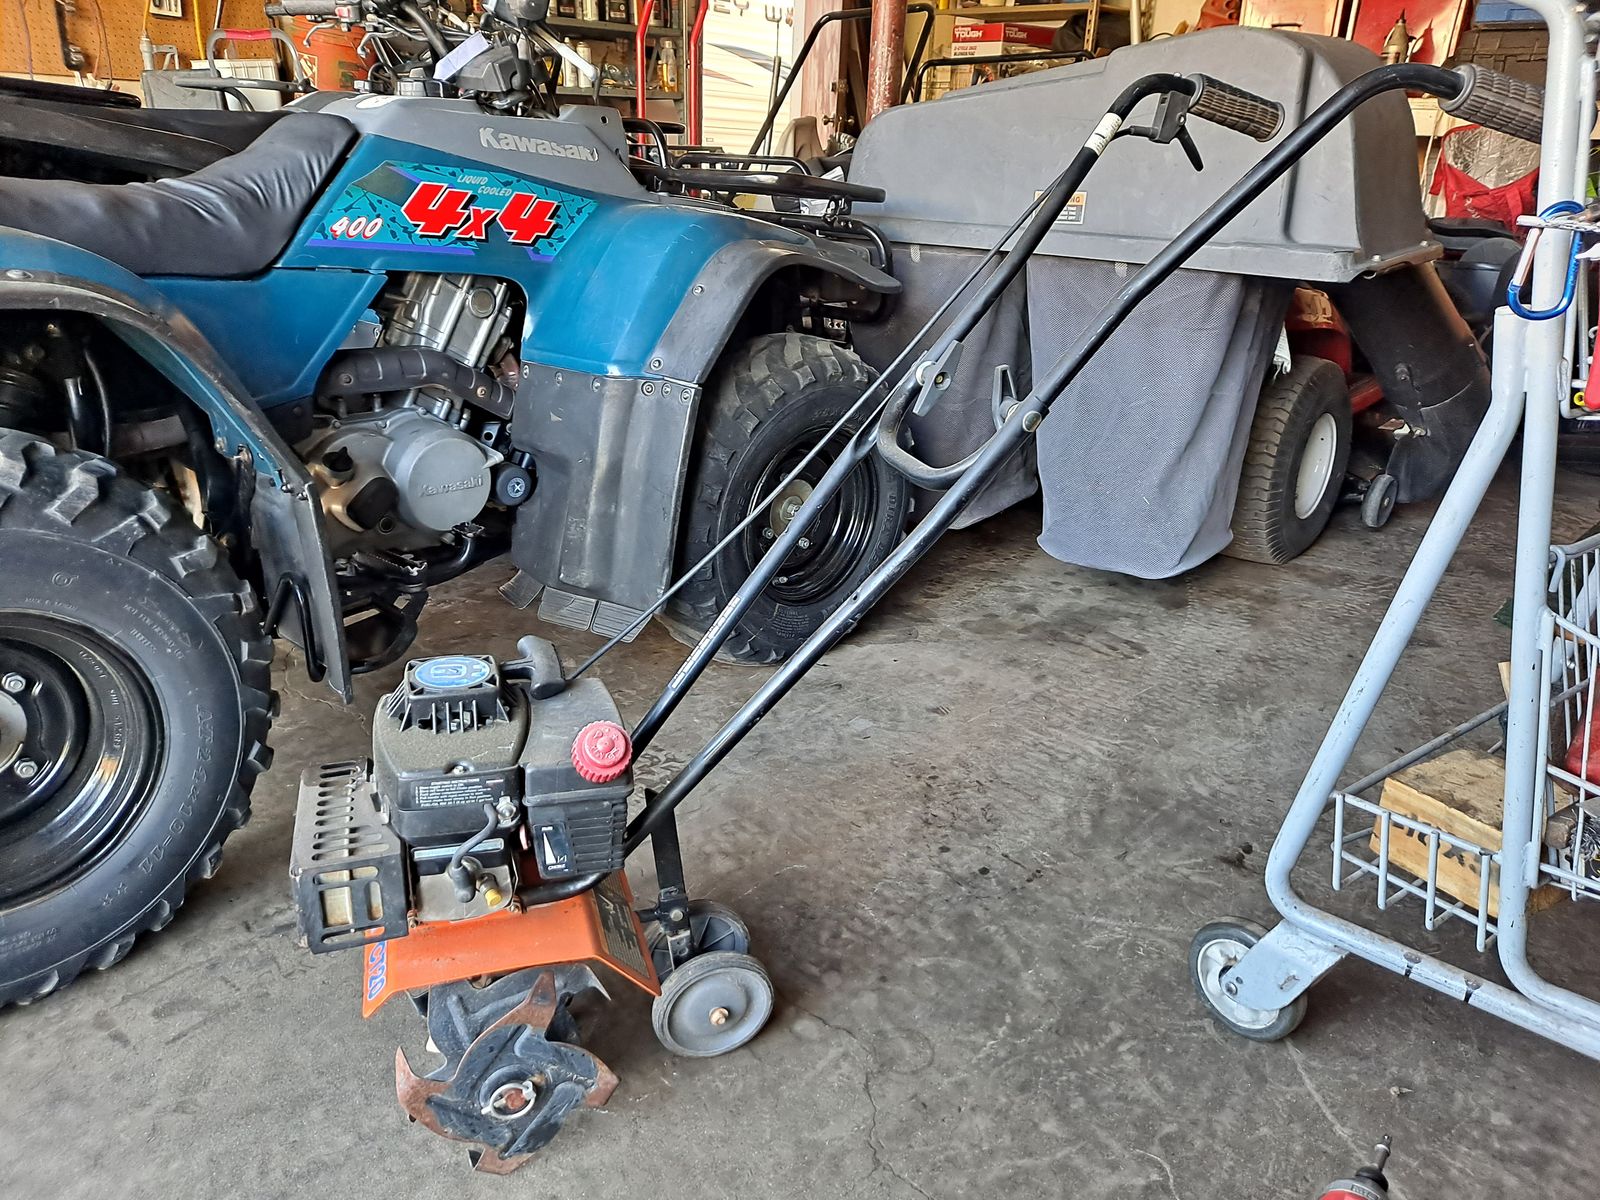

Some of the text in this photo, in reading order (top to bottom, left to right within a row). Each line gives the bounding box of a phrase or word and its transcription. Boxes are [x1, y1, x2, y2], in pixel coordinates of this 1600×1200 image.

[457, 174, 488, 186] LIQUID
[477, 184, 512, 197] COOLED
[329, 216, 384, 240] 400
